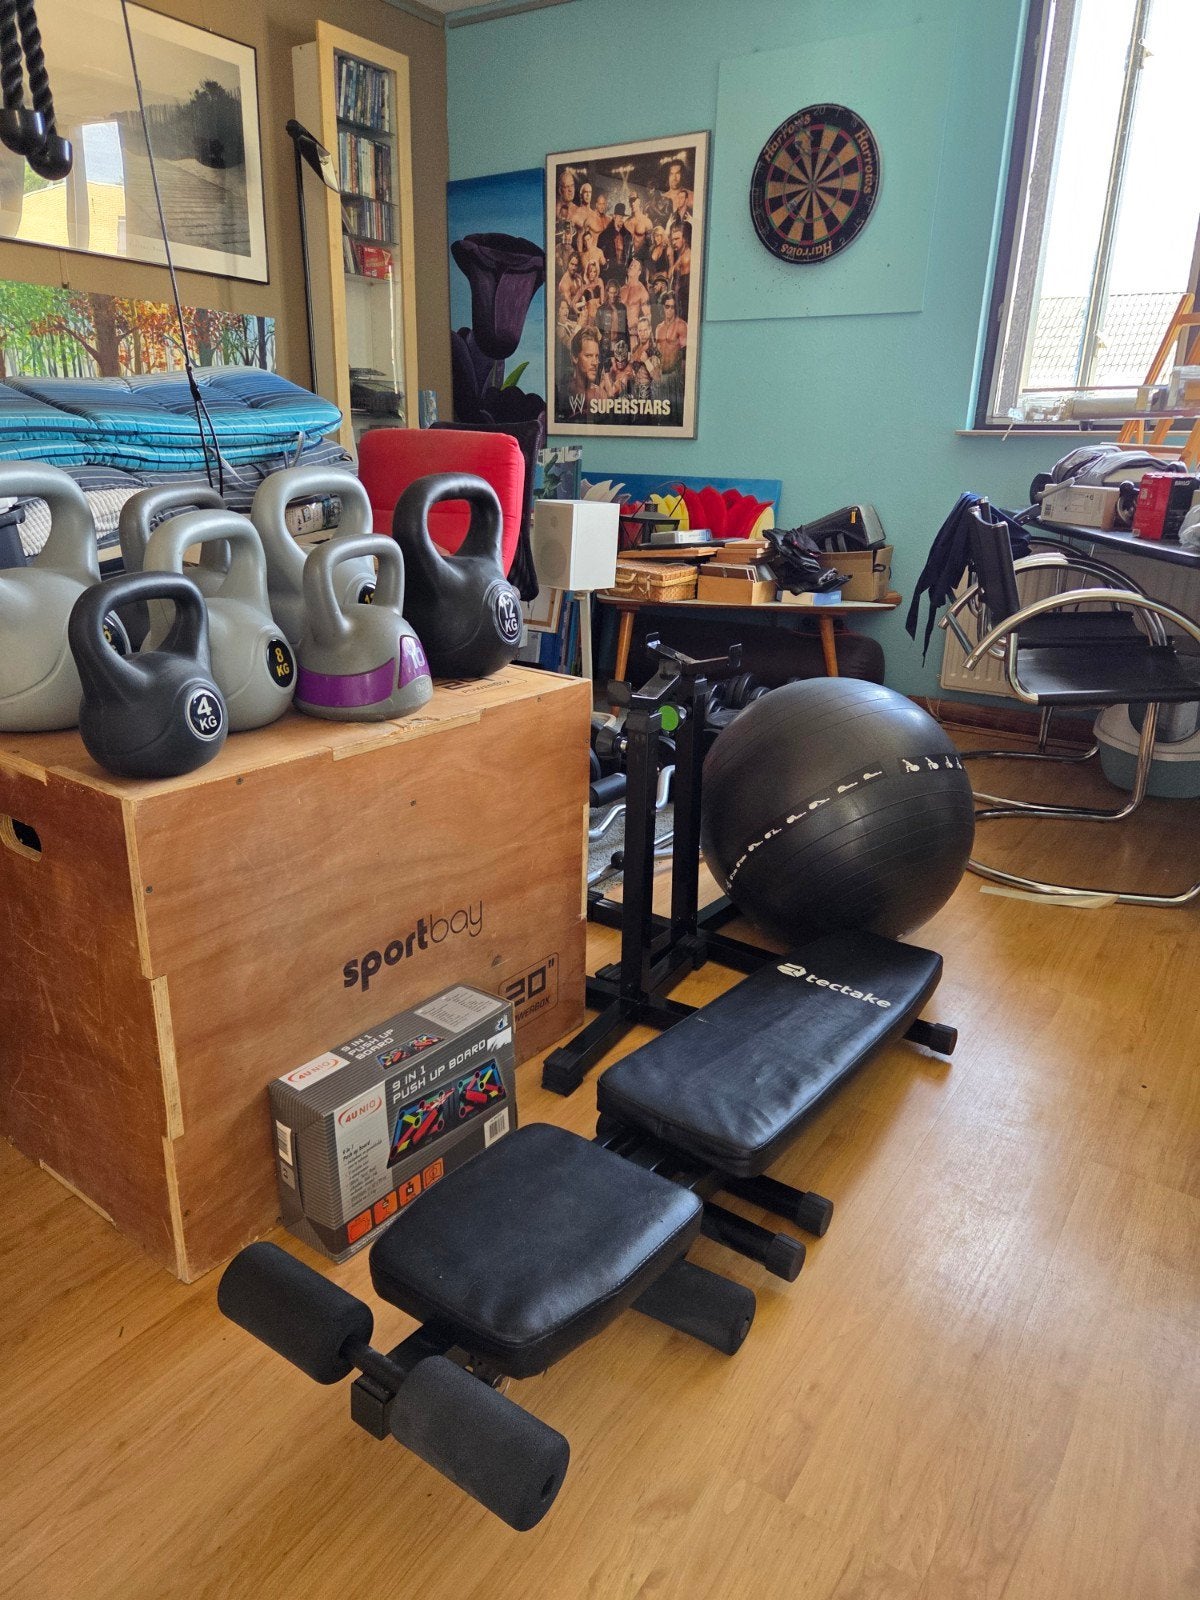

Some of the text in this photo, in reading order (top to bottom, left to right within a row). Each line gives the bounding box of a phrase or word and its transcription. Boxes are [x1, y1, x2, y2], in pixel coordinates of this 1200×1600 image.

[761, 113, 811, 163] Harrows
[855, 129, 874, 195] Harrows
[780, 240, 833, 257] Harrows
[590, 398, 671, 416] SUPERSTARS
[502, 597, 516, 619] 12
[505, 618, 518, 633] KG
[274, 647, 284, 664] 8
[276, 662, 290, 678] KG
[197, 696, 213, 717] 4
[199, 714, 218, 731] KG
[343, 900, 483, 993] sportbay
[805, 974, 892, 1008] tectake
[341, 1045, 351, 1053] 9
[351, 1038, 365, 1047] IN
[348, 1028, 394, 1056] PUSH UP
[355, 1037, 395, 1060] BOARD
[392, 1064, 426, 1093] 9 IN 1
[393, 1039, 486, 1105] PUSH UP BOARD
